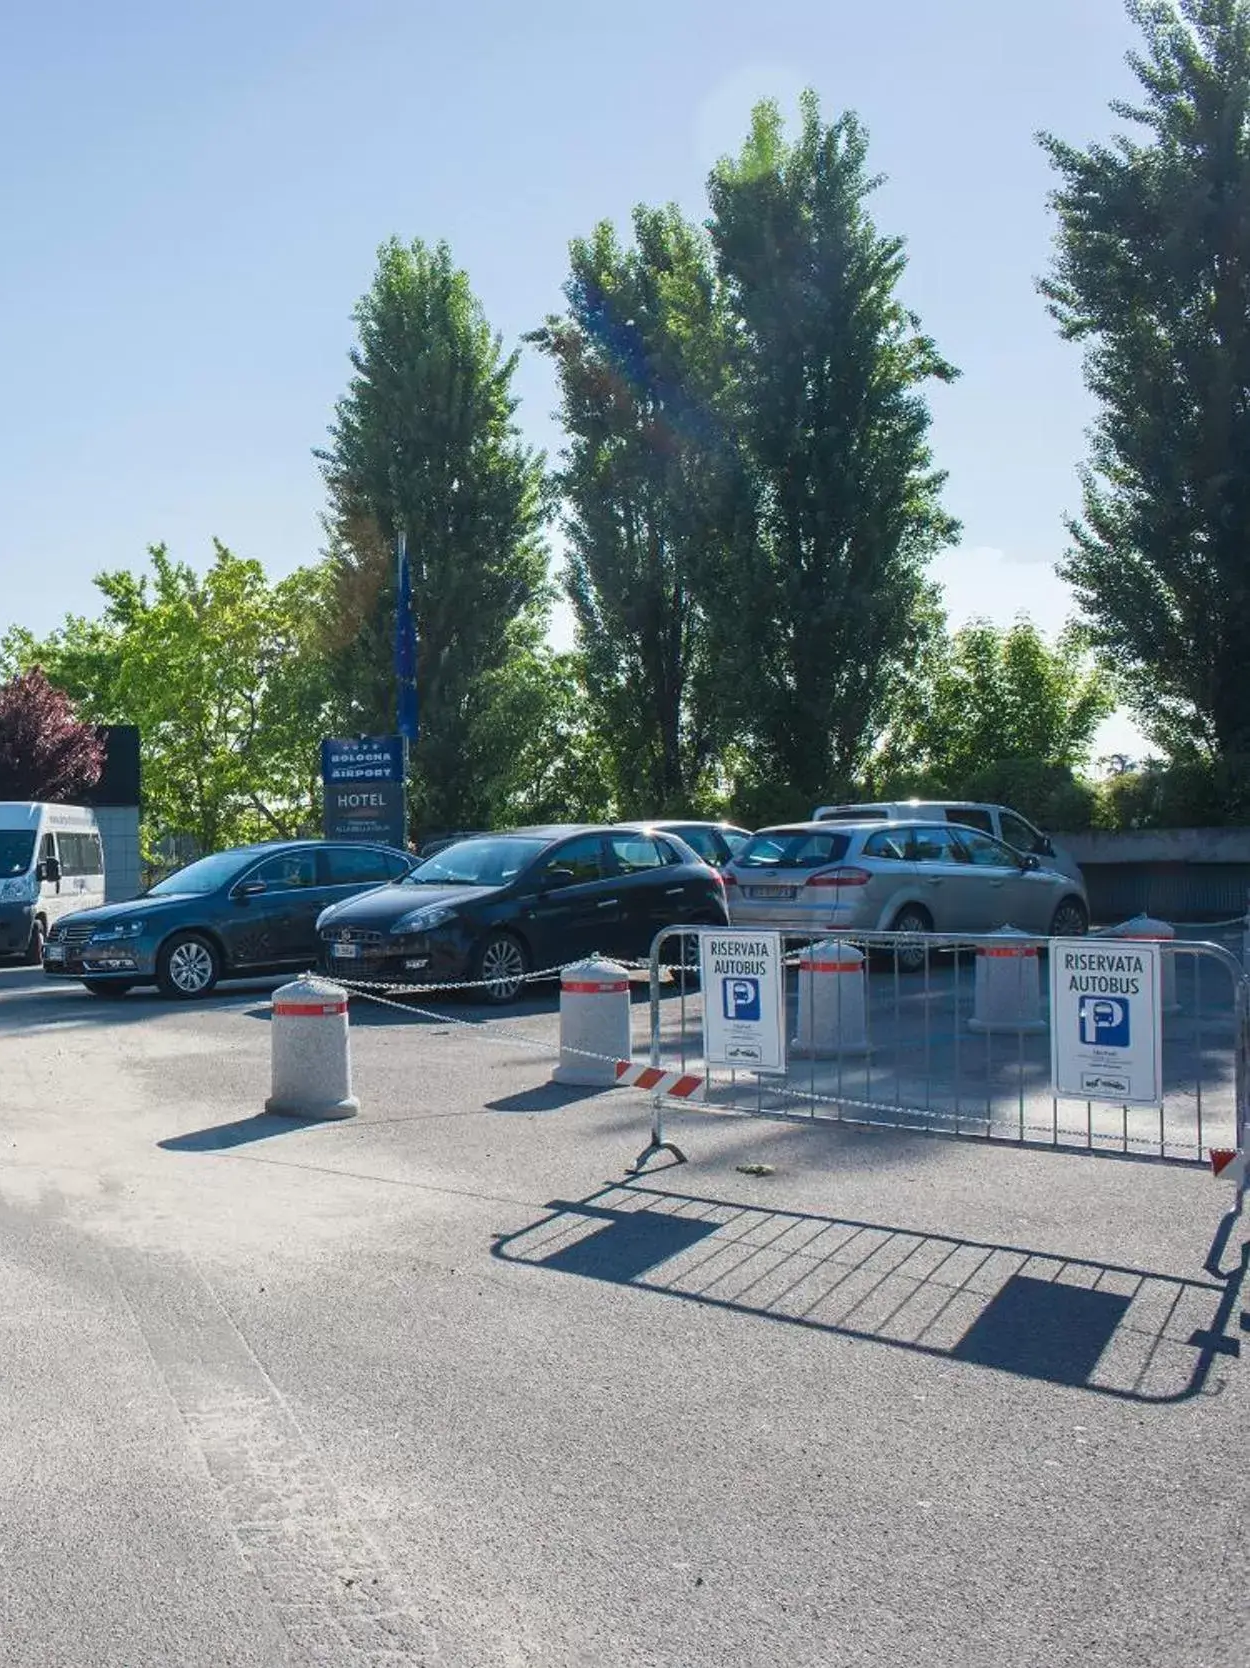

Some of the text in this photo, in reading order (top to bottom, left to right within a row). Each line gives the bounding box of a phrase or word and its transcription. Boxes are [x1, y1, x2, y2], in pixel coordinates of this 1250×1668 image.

[331, 753, 391, 762] BOLOGNA
[331, 769, 391, 778] AIRPORT
[337, 793, 387, 808] HOTEL
[711, 940, 770, 958] RISERVATA
[714, 959, 766, 976] AUTOBUS
[1065, 953, 1144, 974] RISERVATA
[1069, 976, 1140, 994] AUTOBUS
